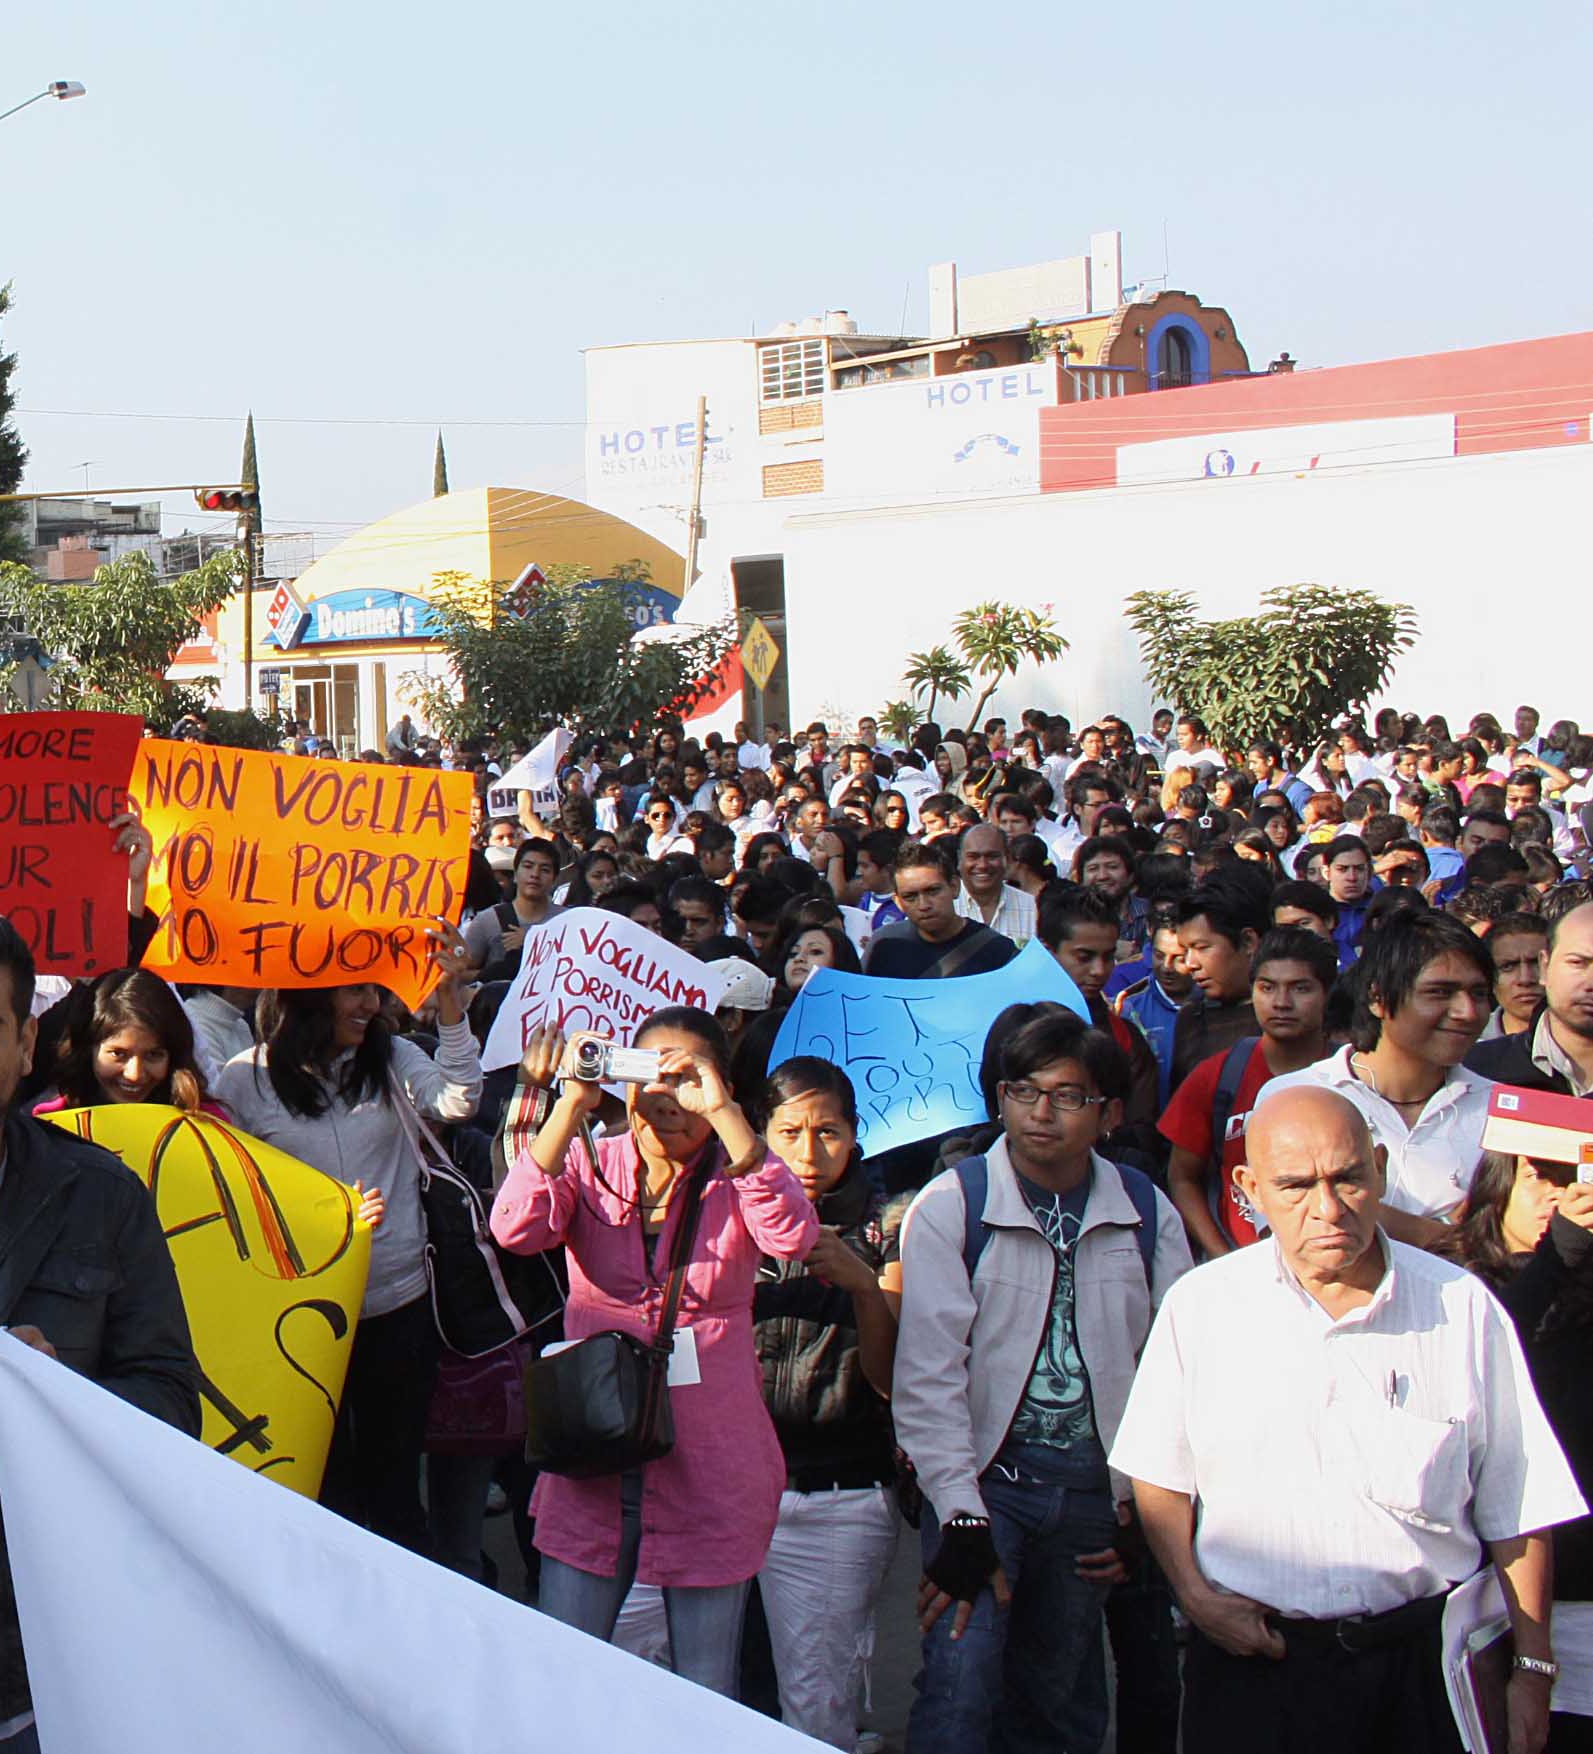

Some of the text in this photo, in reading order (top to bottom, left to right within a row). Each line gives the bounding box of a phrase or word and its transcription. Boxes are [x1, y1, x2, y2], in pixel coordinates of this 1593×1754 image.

[927, 372, 1044, 409] HOTEL
[600, 421, 724, 457] HOTEL
[316, 596, 416, 639] Domino's
[144, 747, 472, 837] NON VOGLIA-
[228, 832, 279, 906] IL
[523, 924, 568, 971] NON
[520, 970, 540, 1000] IL
